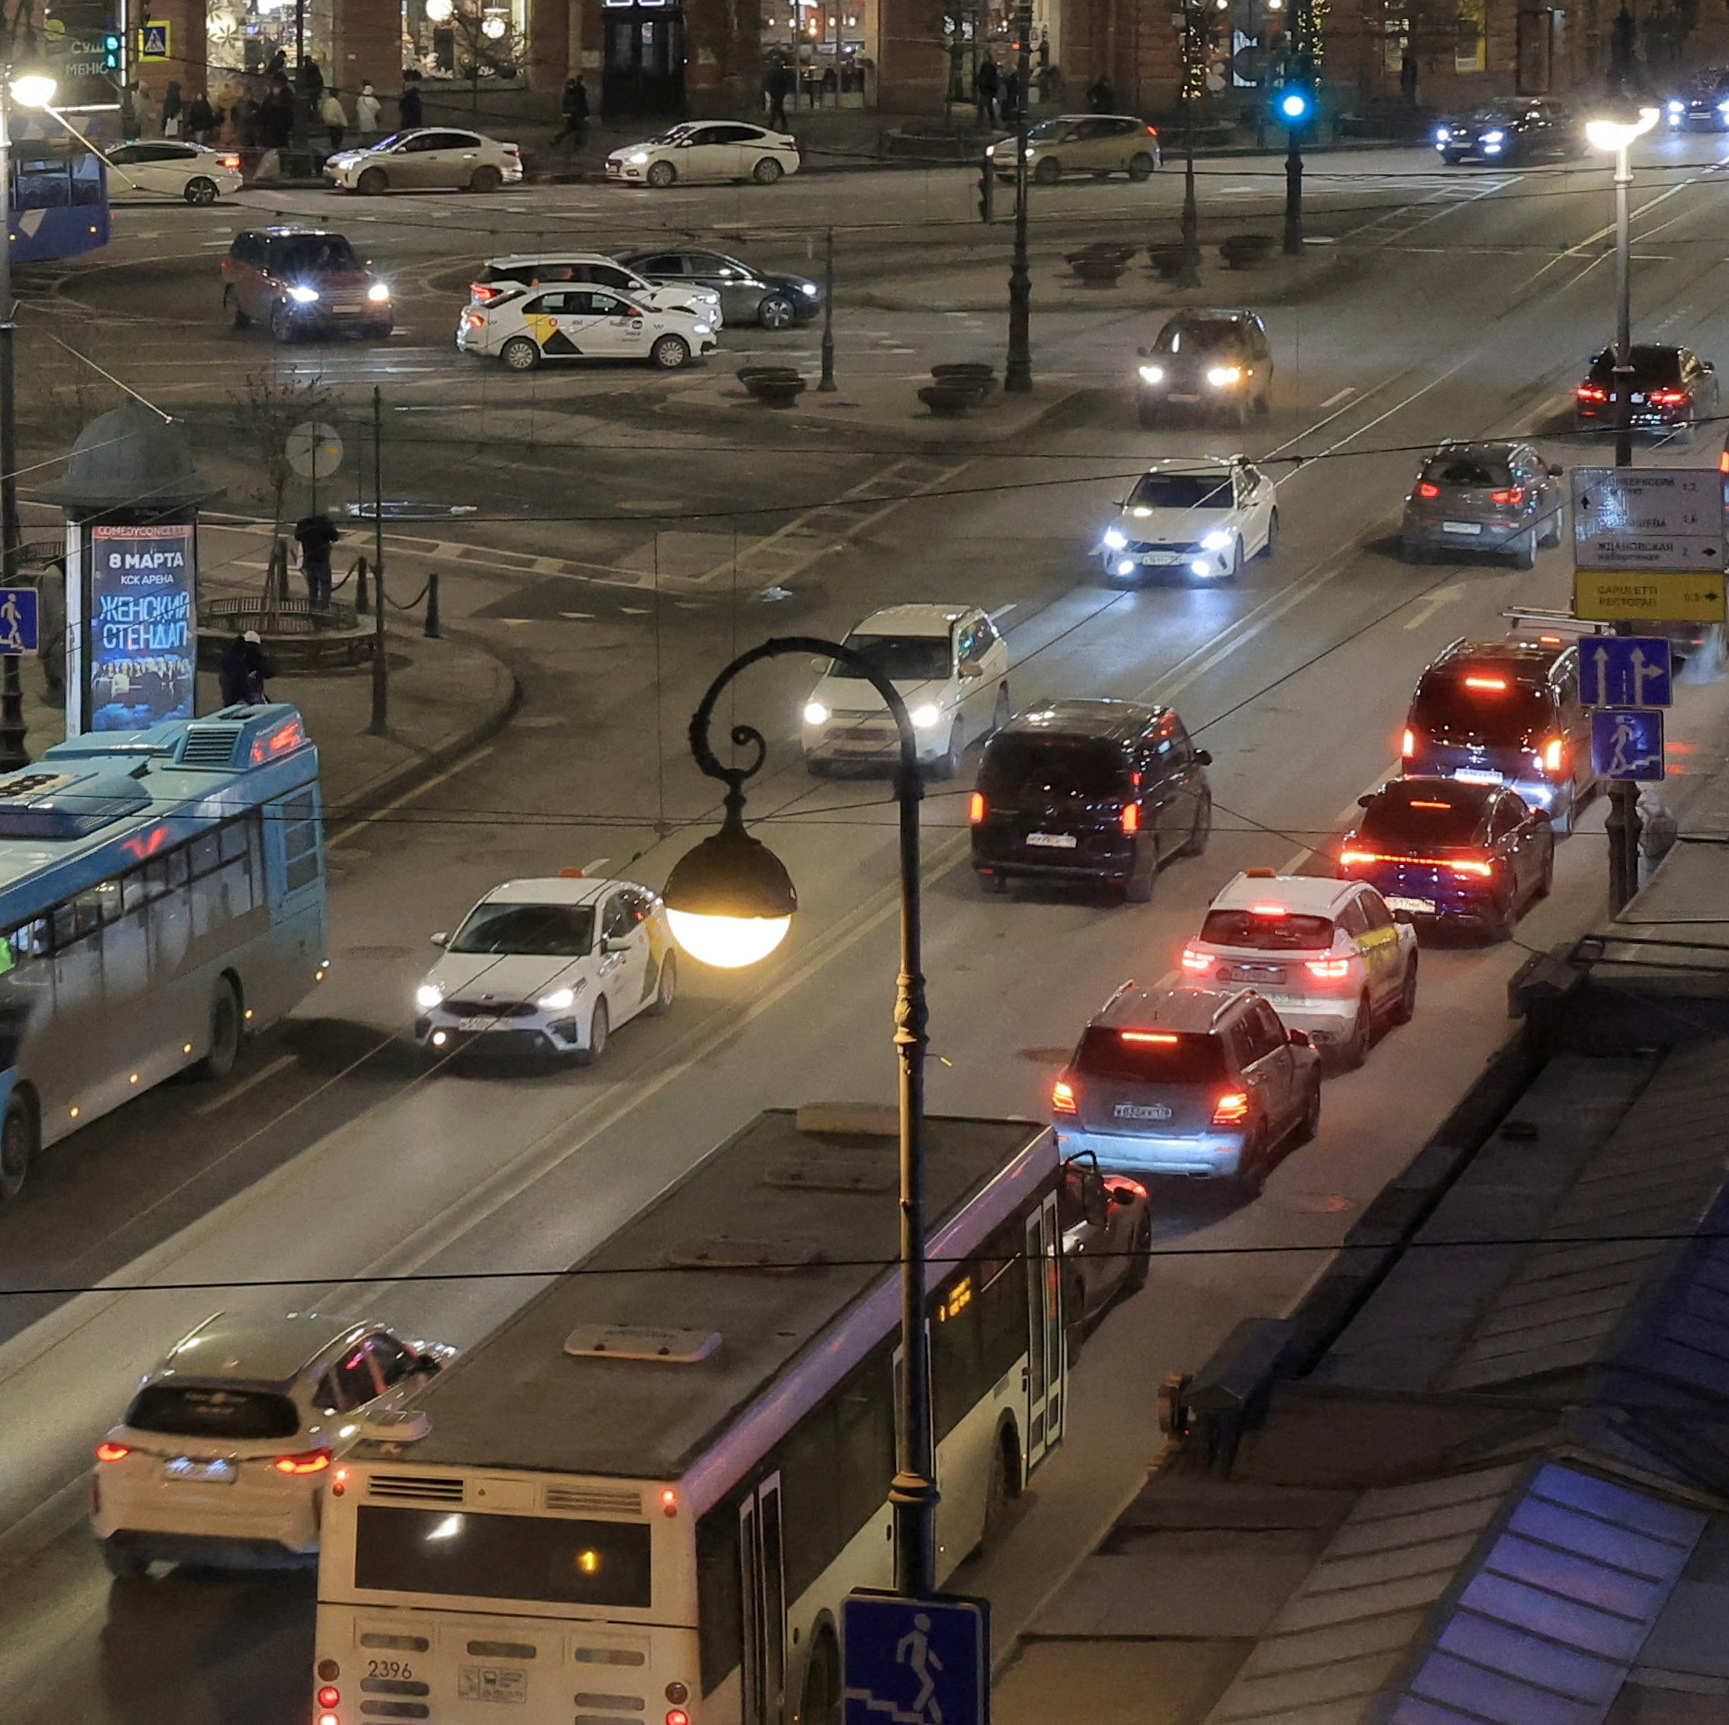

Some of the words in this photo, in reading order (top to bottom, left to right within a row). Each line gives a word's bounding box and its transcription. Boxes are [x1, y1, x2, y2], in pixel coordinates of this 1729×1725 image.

[109, 553, 122, 568] 8
[125, 552, 184, 569] МАРТА
[120, 575, 140, 585] КСК
[141, 574, 174, 584] АРЕНА
[100, 591, 189, 622] ЖЕНСКИЙ
[103, 621, 187, 650] СТЕНДАП
[581, 1551, 595, 1571] 1
[369, 1661, 412, 1679] 2396
